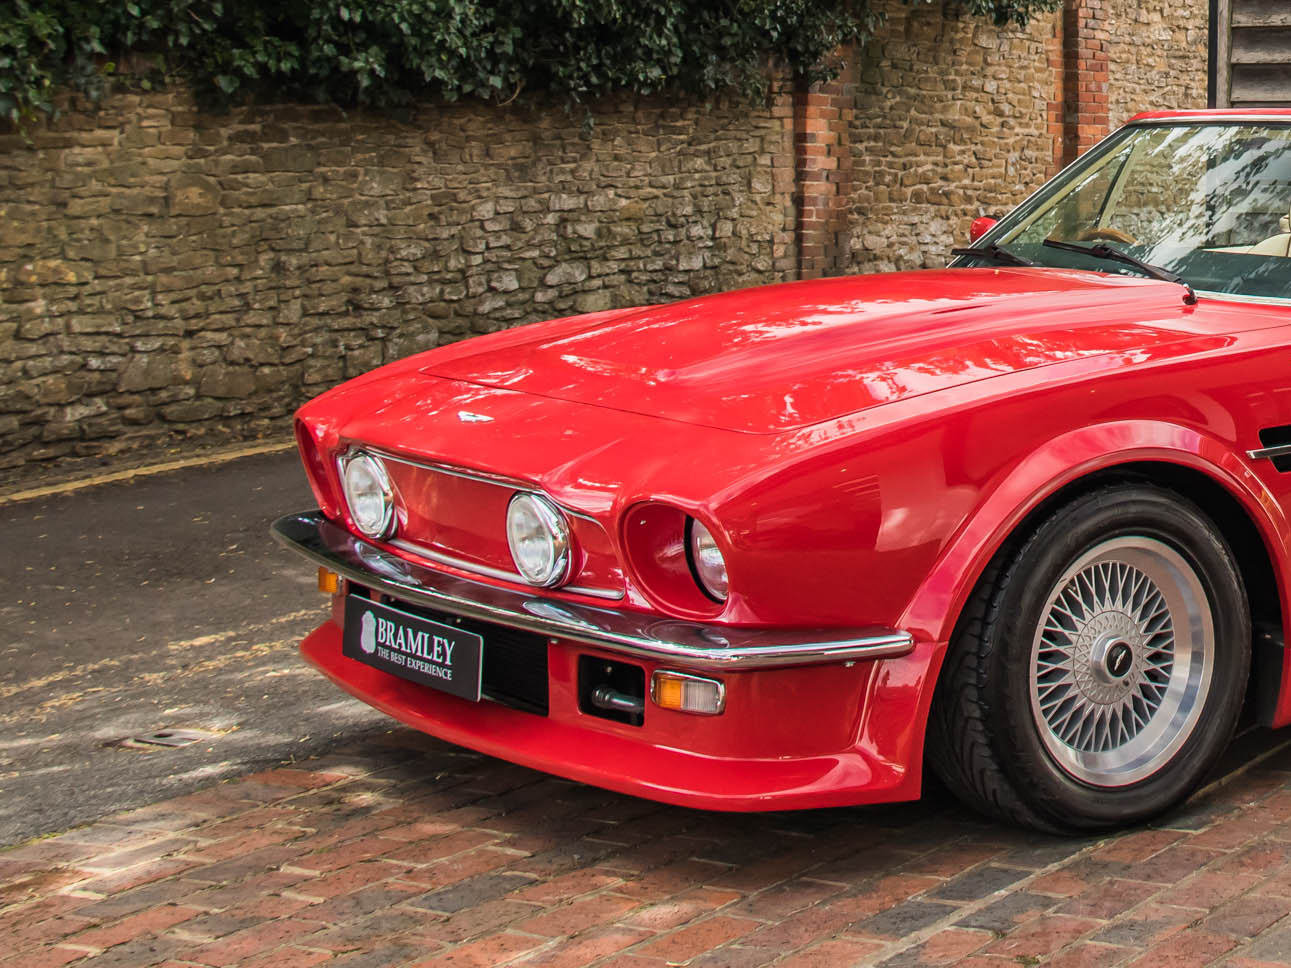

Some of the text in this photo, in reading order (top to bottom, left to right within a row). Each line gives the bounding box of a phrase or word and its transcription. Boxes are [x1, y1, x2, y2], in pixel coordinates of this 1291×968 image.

[377, 617, 456, 666] BRAMLEY
[377, 646, 453, 681] THE BEST EXPERIENCE
